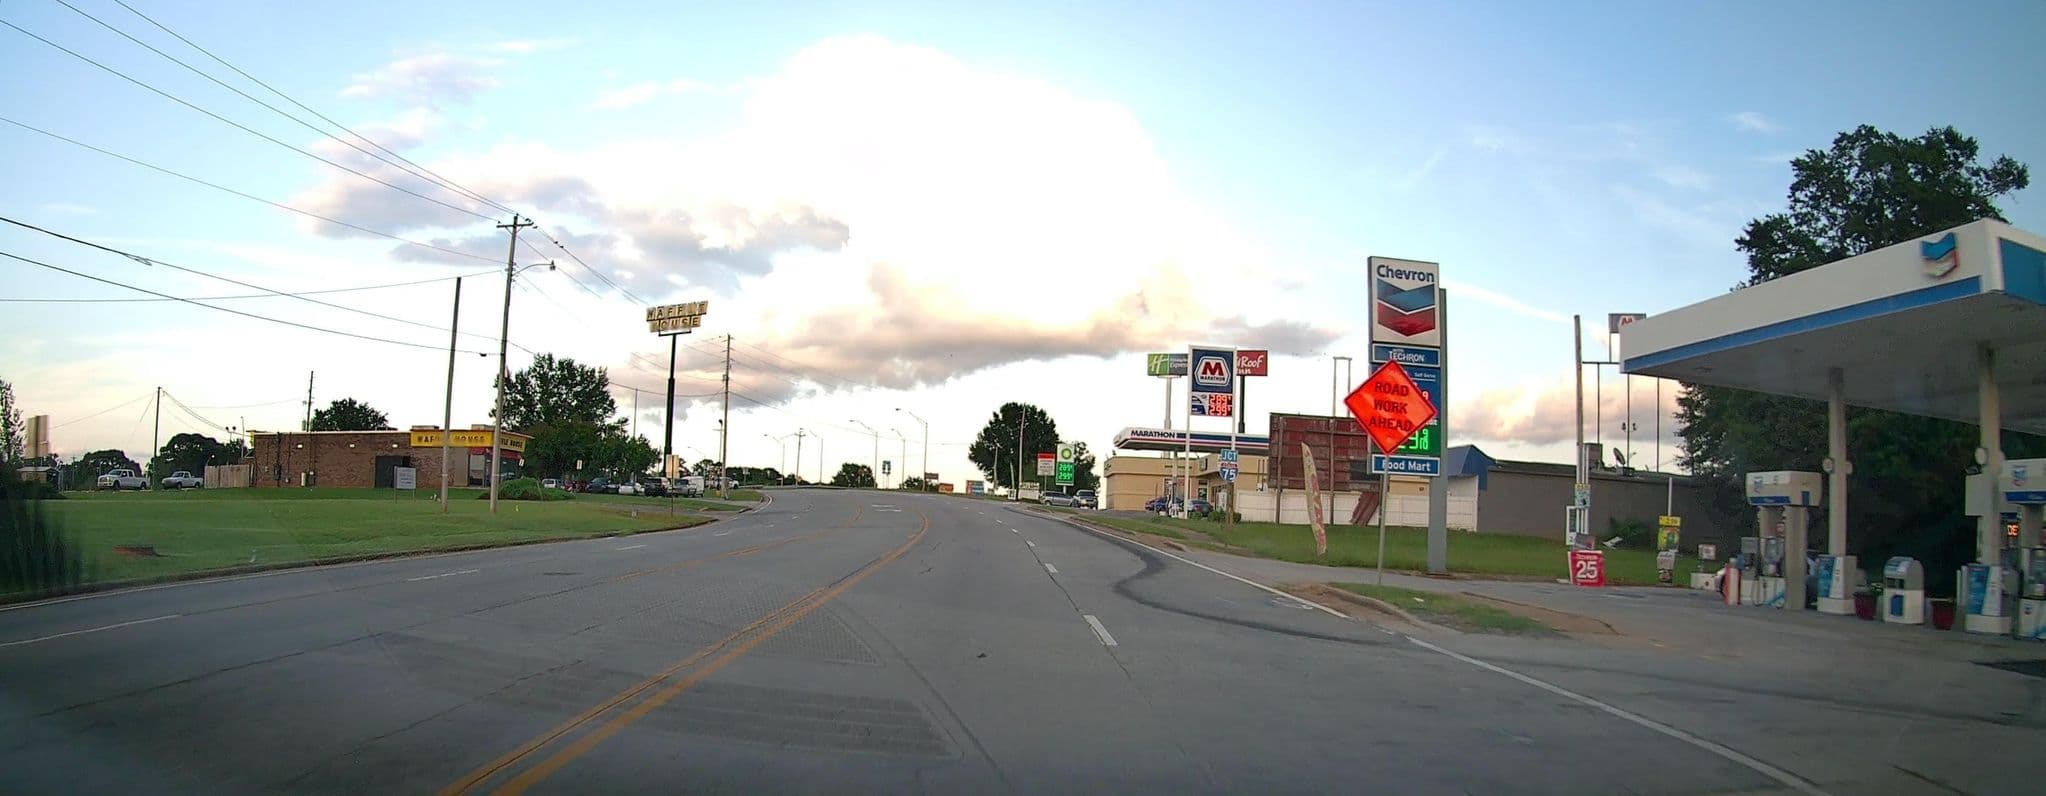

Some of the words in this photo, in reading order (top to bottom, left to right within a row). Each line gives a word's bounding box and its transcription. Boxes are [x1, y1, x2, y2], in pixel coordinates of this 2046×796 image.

[1377, 264, 1434, 282] Chevron
[1388, 350, 1425, 363] TECHRON
[1376, 383, 1409, 396] ROAD
[1374, 399, 1408, 414] WORK
[1369, 416, 1413, 432] AHEAD
[1131, 430, 1175, 438] MARATHON
[1408, 461, 1431, 472] Mart
[1222, 469, 1236, 480] 75
[1576, 560, 1598, 579] 25
